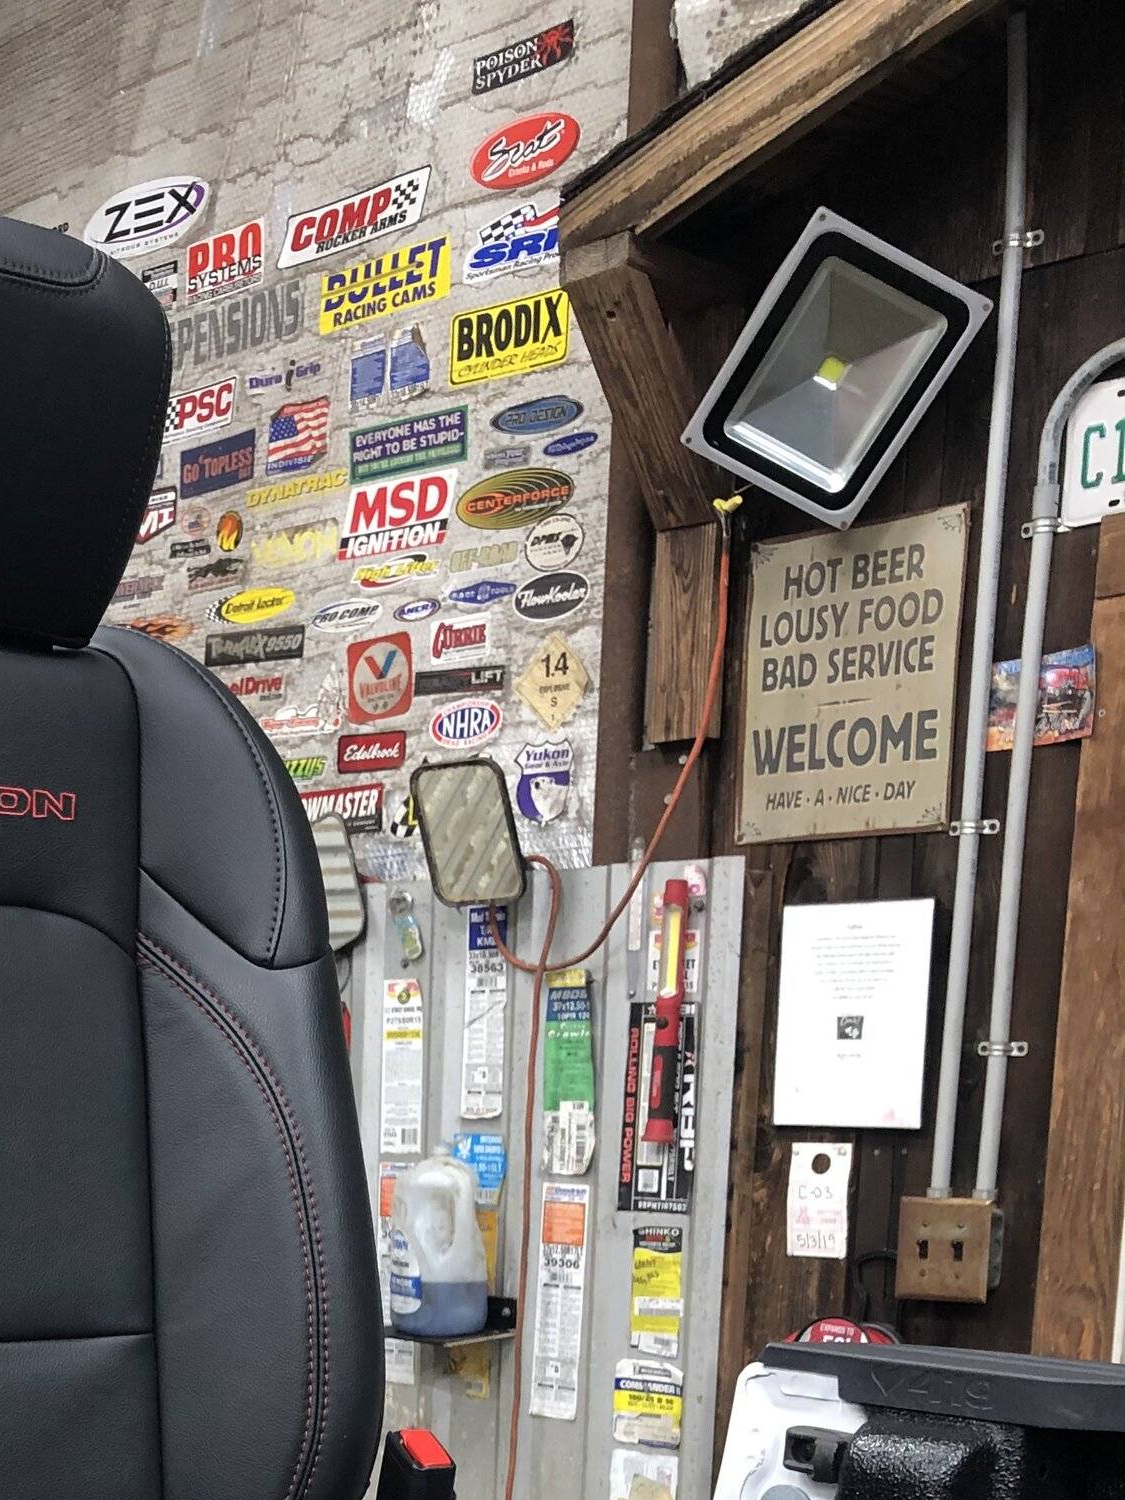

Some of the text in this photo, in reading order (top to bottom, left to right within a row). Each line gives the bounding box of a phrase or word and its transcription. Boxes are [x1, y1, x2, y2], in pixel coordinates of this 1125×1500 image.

[475, 37, 539, 76] POISON
[475, 55, 542, 90] SPYDER
[481, 119, 565, 182] Scat
[104, 181, 197, 243] ZEX
[290, 187, 392, 252] COMP
[188, 222, 262, 278] PRO
[316, 210, 408, 254] ROCKER ARMS
[188, 254, 262, 292] SYSTEMS
[323, 237, 447, 312] BULLET
[466, 263, 512, 280] Sportsman
[513, 257, 542, 269] Racing
[333, 282, 435, 327] RACING CAMS
[174, 280, 301, 369] PENSIONS
[457, 292, 563, 362] BRODIX
[458, 354, 518, 378] CYLINDER
[176, 382, 233, 430] PSC
[355, 412, 461, 447] EVERYONE HAS THE
[353, 445, 383, 462] RIGHT
[386, 441, 400, 455] TO
[402, 438, 417, 451] BE
[183, 463, 199, 485] GO
[246, 467, 348, 508] DYNATRAC
[349, 476, 448, 533] MSD
[467, 485, 569, 511] CENTERFORCE
[346, 520, 441, 558] IGNITION
[783, 543, 925, 601] HOT BEER
[397, 602, 437, 616] ANCRA
[518, 582, 587, 609] FlowKooler
[312, 605, 380, 625] PRO COMP
[759, 588, 944, 649] LOUSY FOOD
[266, 633, 302, 653] 9550
[471, 669, 503, 685] LIFT
[540, 651, 569, 678] 1.4
[761, 635, 935, 692] BAD SERVICE
[550, 697, 557, 707] S
[442, 708, 492, 738] NHRA
[752, 708, 938, 776] WELCOME
[342, 742, 400, 763] Edelbrock
[525, 748, 569, 761] Yukon
[765, 780, 917, 811] HAVE A NICE DAY
[621, 1027, 641, 1184] ROLLING BIG POWER
[638, 1228, 680, 1236] SHINKO
